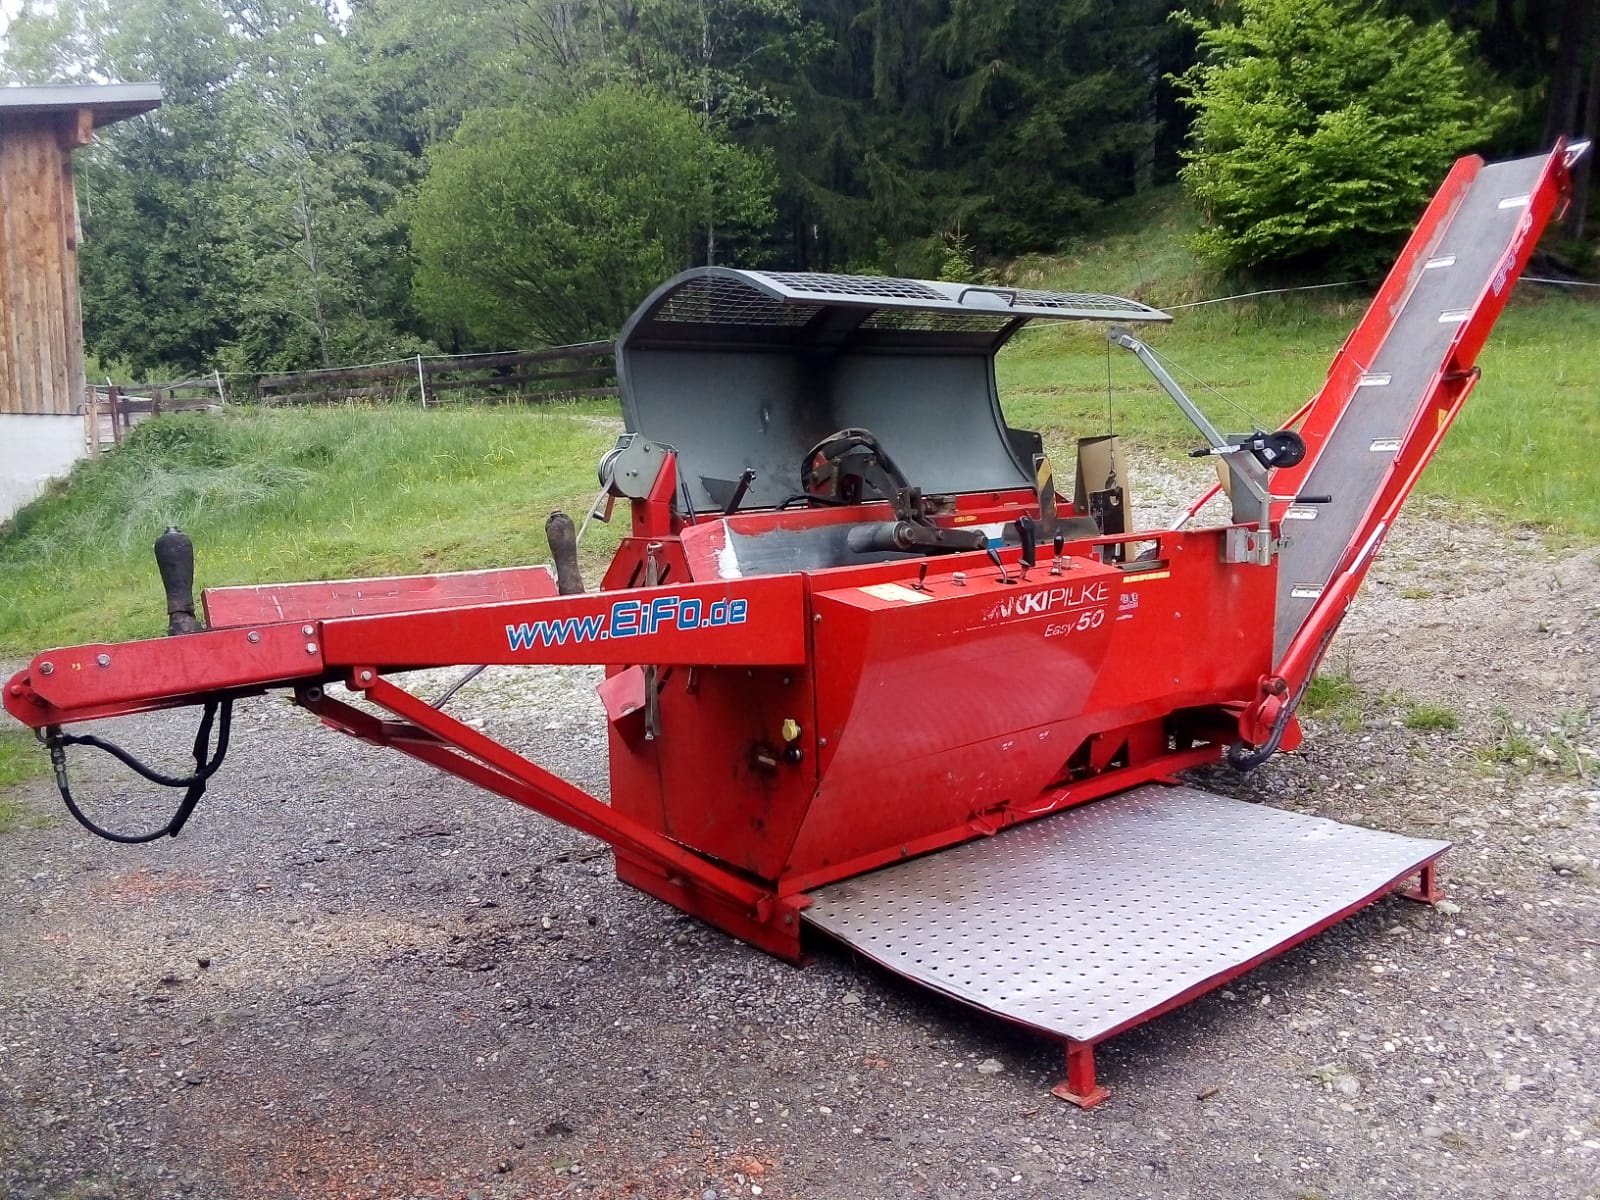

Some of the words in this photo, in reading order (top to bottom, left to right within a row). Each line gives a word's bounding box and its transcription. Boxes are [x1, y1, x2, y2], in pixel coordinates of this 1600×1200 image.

[505, 596, 748, 651] www.EiFo.de
[1044, 621, 1075, 638] Easy
[1076, 609, 1106, 631] 50
